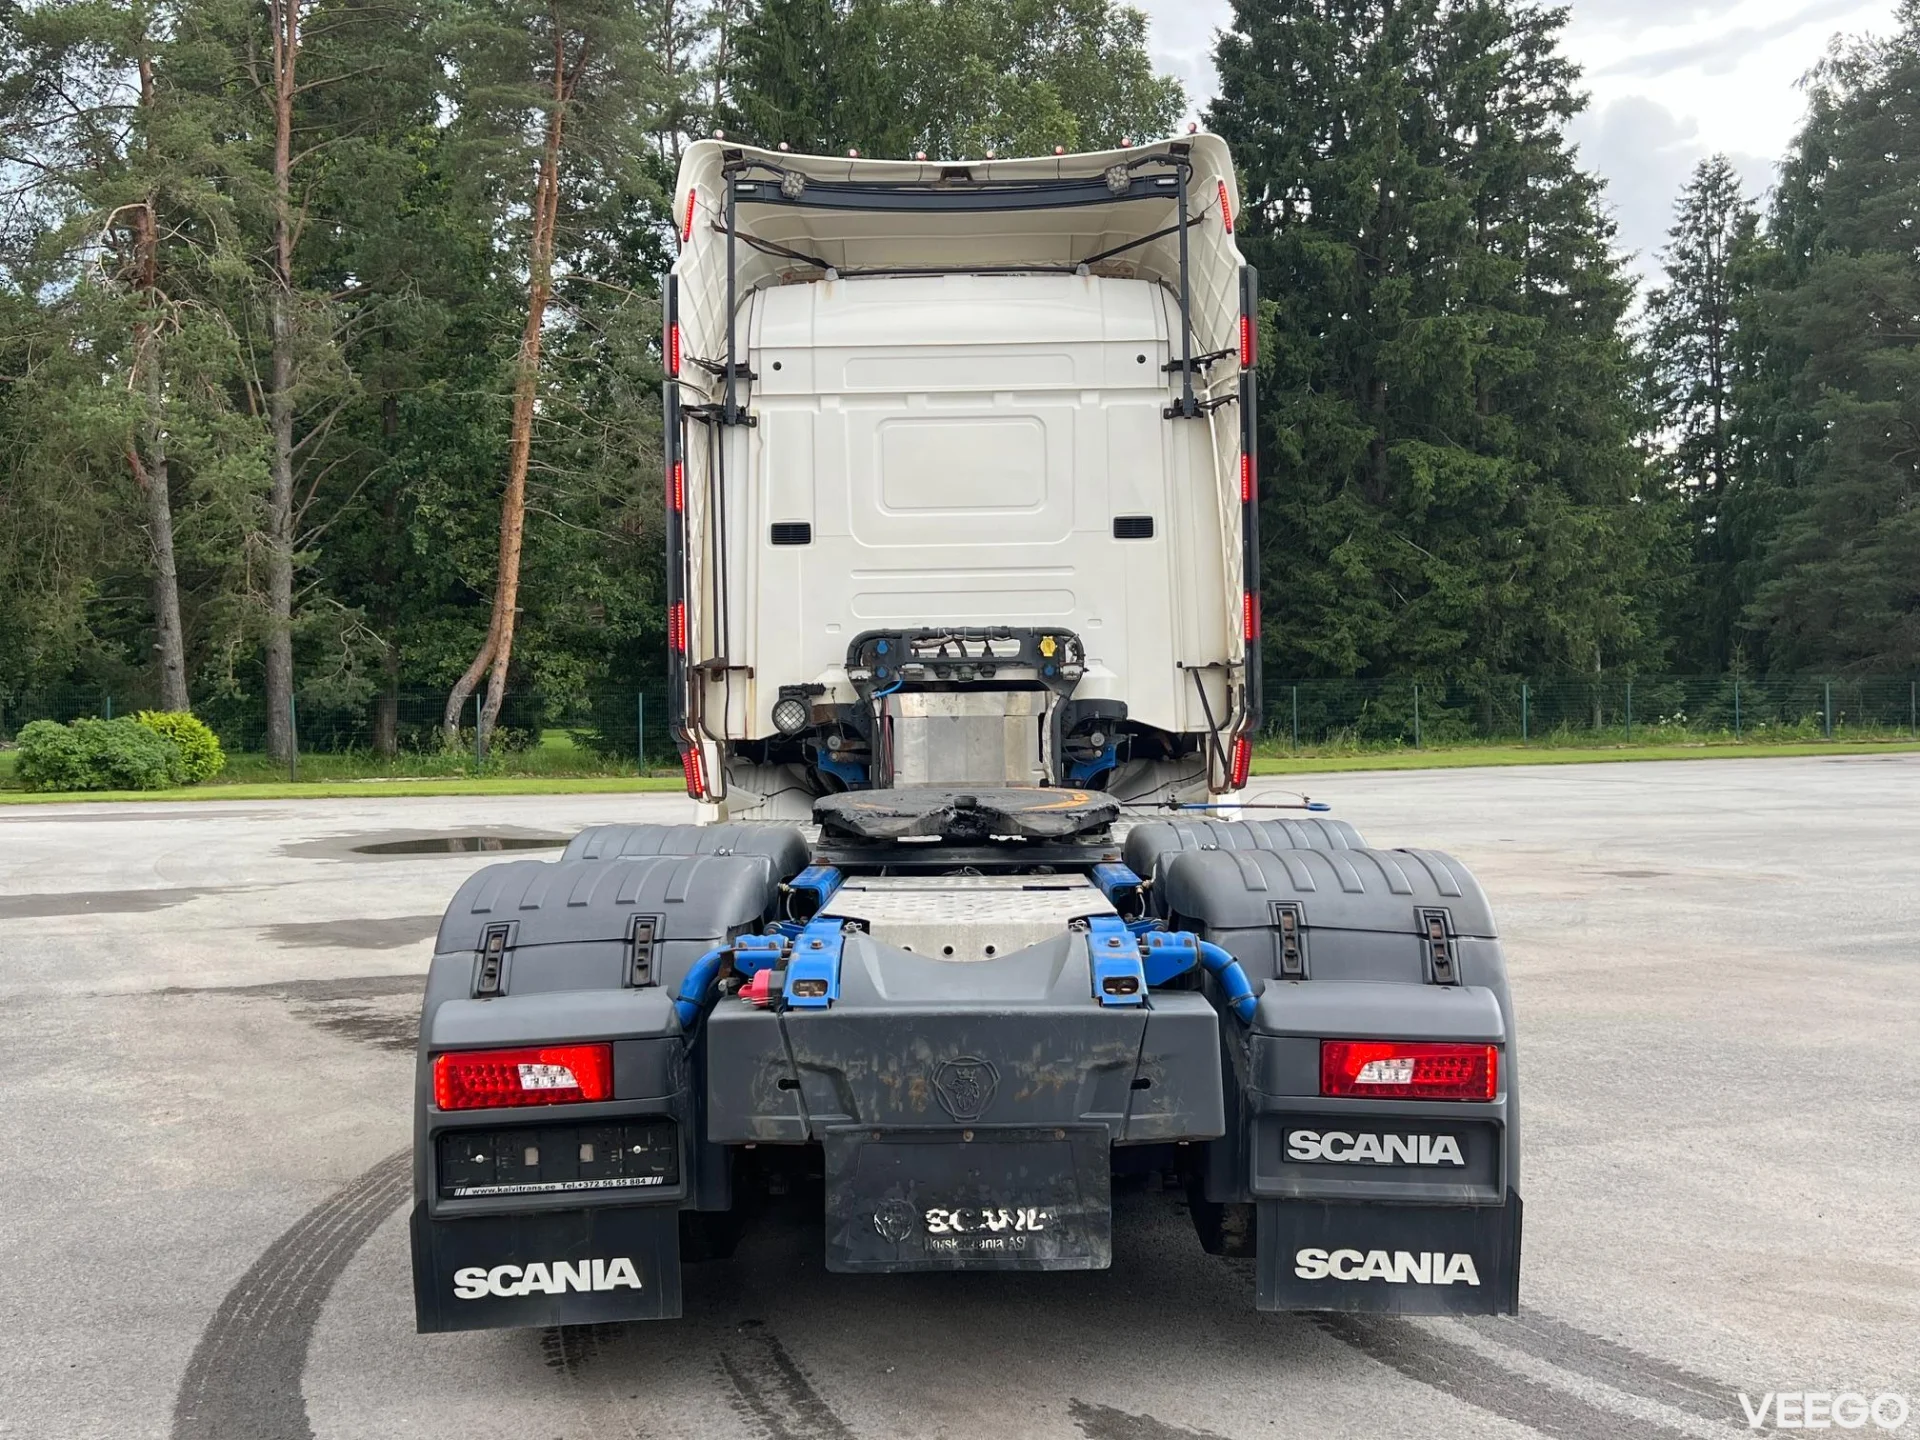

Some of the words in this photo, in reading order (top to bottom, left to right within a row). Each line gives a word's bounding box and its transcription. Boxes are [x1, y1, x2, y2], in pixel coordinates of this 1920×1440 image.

[1288, 1130, 1465, 1165] SCANIA
[603, 1179, 614, 1188] 56
[616, 1178, 628, 1186] 55
[926, 1207, 1056, 1232] SCNI
[453, 1257, 642, 1299] SCANIA
[1294, 1248, 1481, 1286] SCANIA
